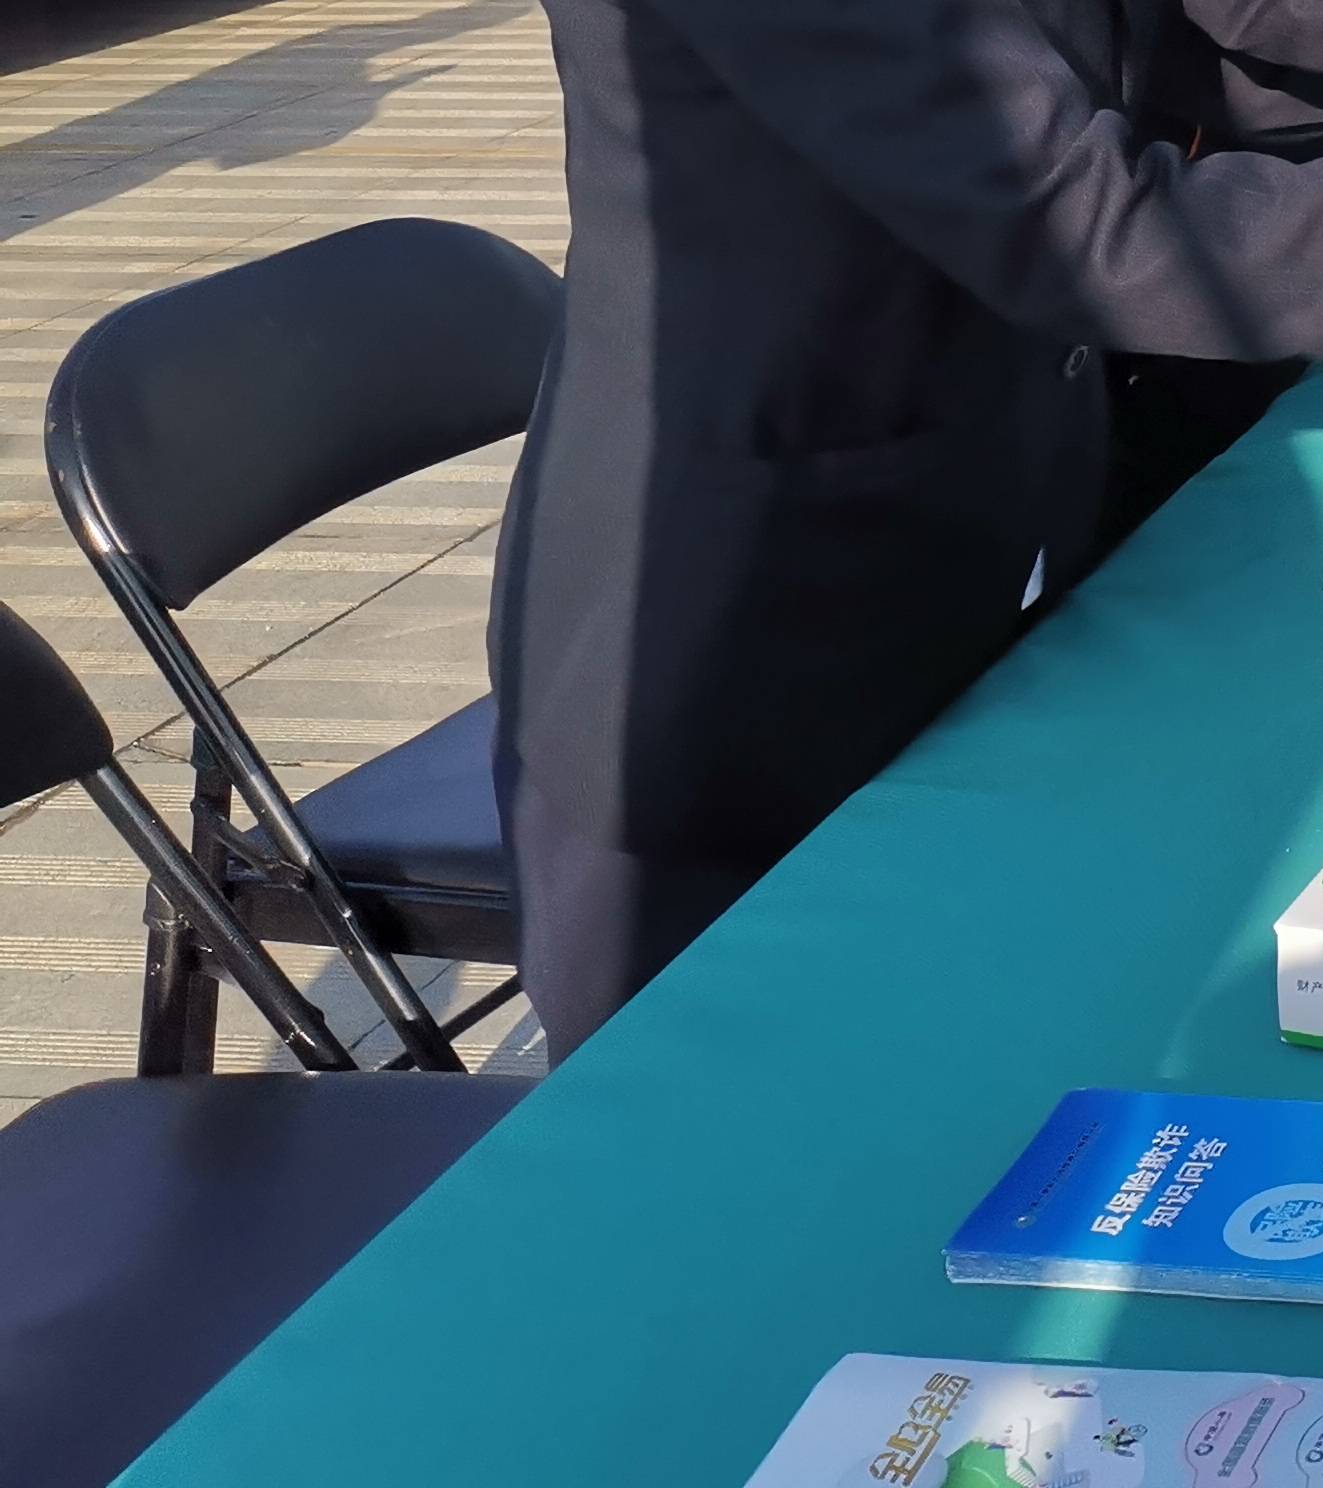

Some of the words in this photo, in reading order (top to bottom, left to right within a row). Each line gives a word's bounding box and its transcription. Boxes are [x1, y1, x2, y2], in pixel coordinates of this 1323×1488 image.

[1090, 1123, 1189, 1236] 反保险欺诈
[1142, 1138, 1227, 1228] 知识问答
